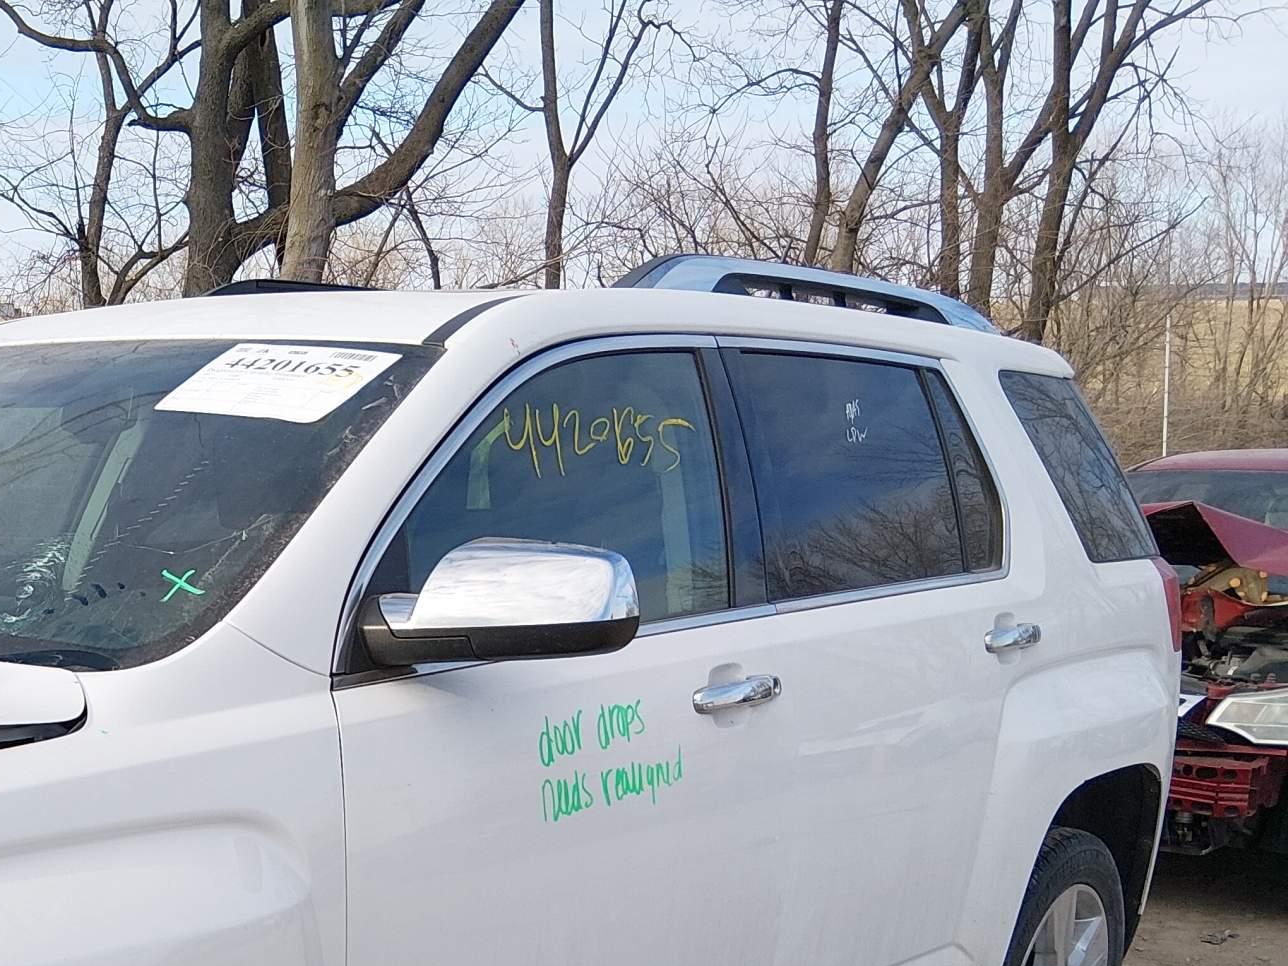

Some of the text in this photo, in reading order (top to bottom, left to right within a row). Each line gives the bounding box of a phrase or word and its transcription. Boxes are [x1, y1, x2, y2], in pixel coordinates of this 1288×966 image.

[225, 357, 361, 378] 44201655
[503, 402, 696, 479] 44201655
[539, 698, 645, 767] door drops
